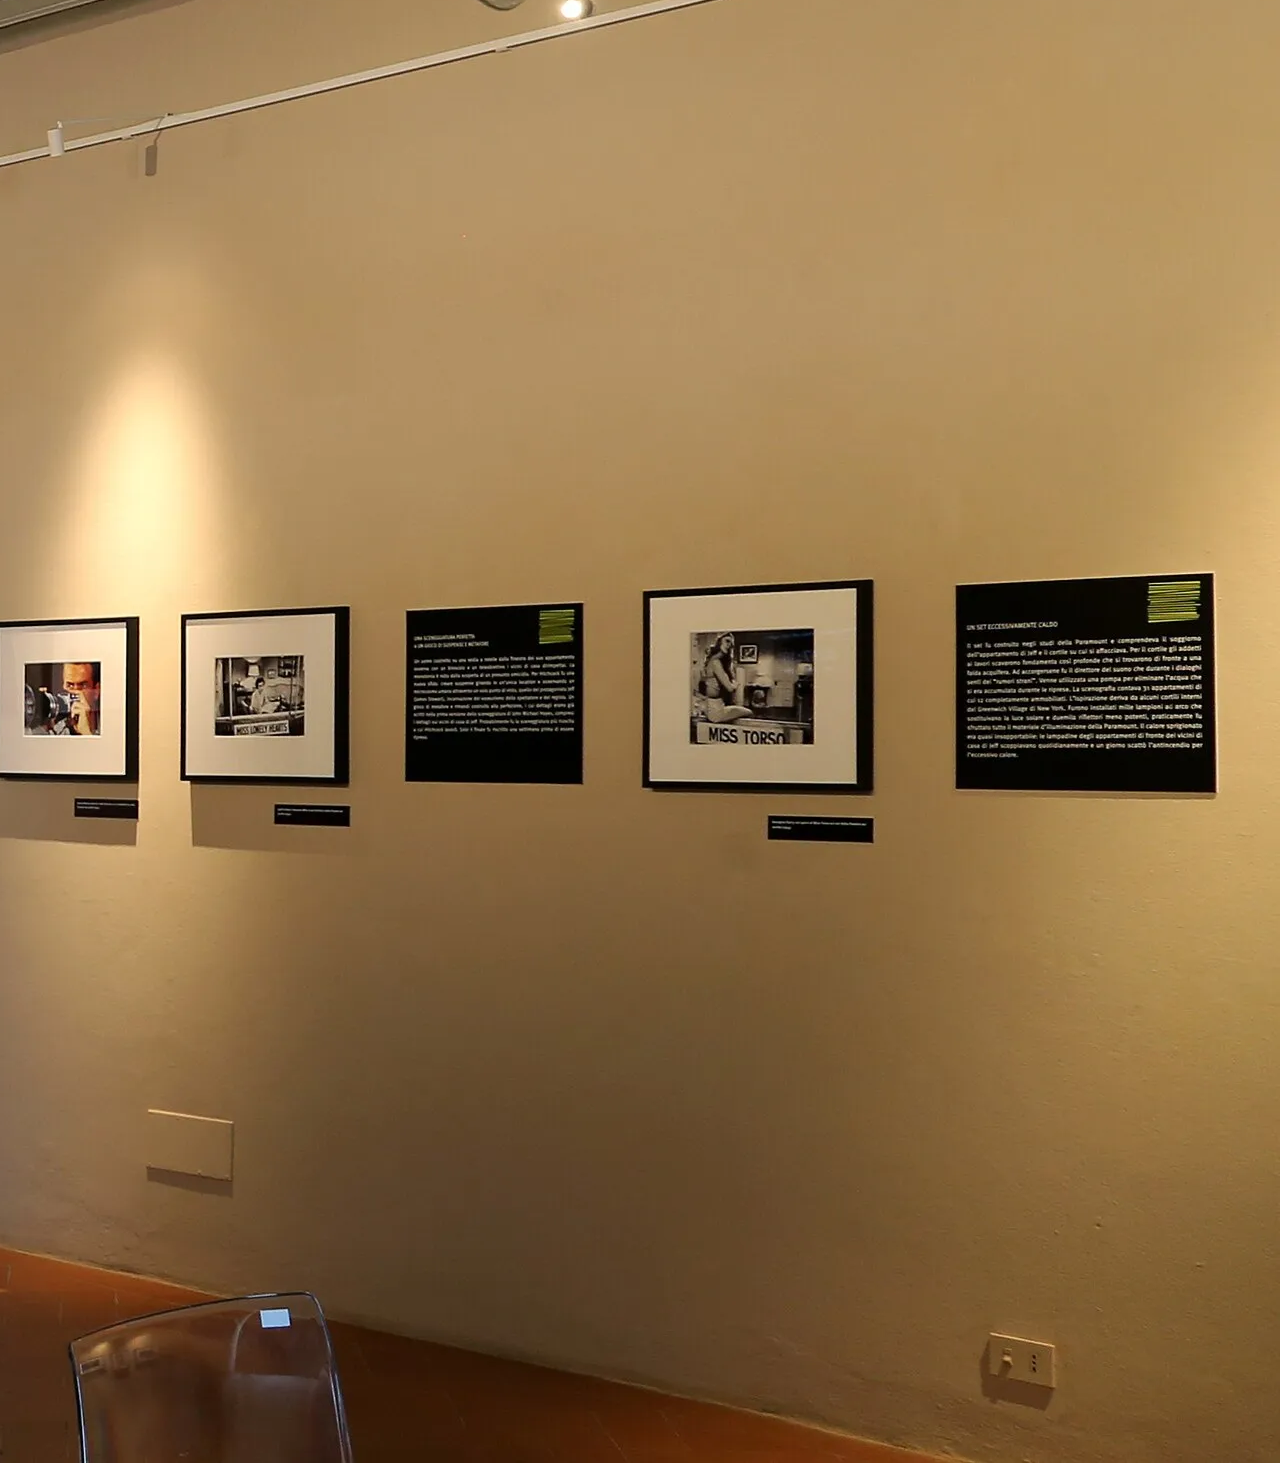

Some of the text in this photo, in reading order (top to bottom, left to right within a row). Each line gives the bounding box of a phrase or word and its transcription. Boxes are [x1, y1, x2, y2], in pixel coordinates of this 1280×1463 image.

[269, 721, 288, 732] HEARTS
[709, 727, 786, 744] MISS TORSO
